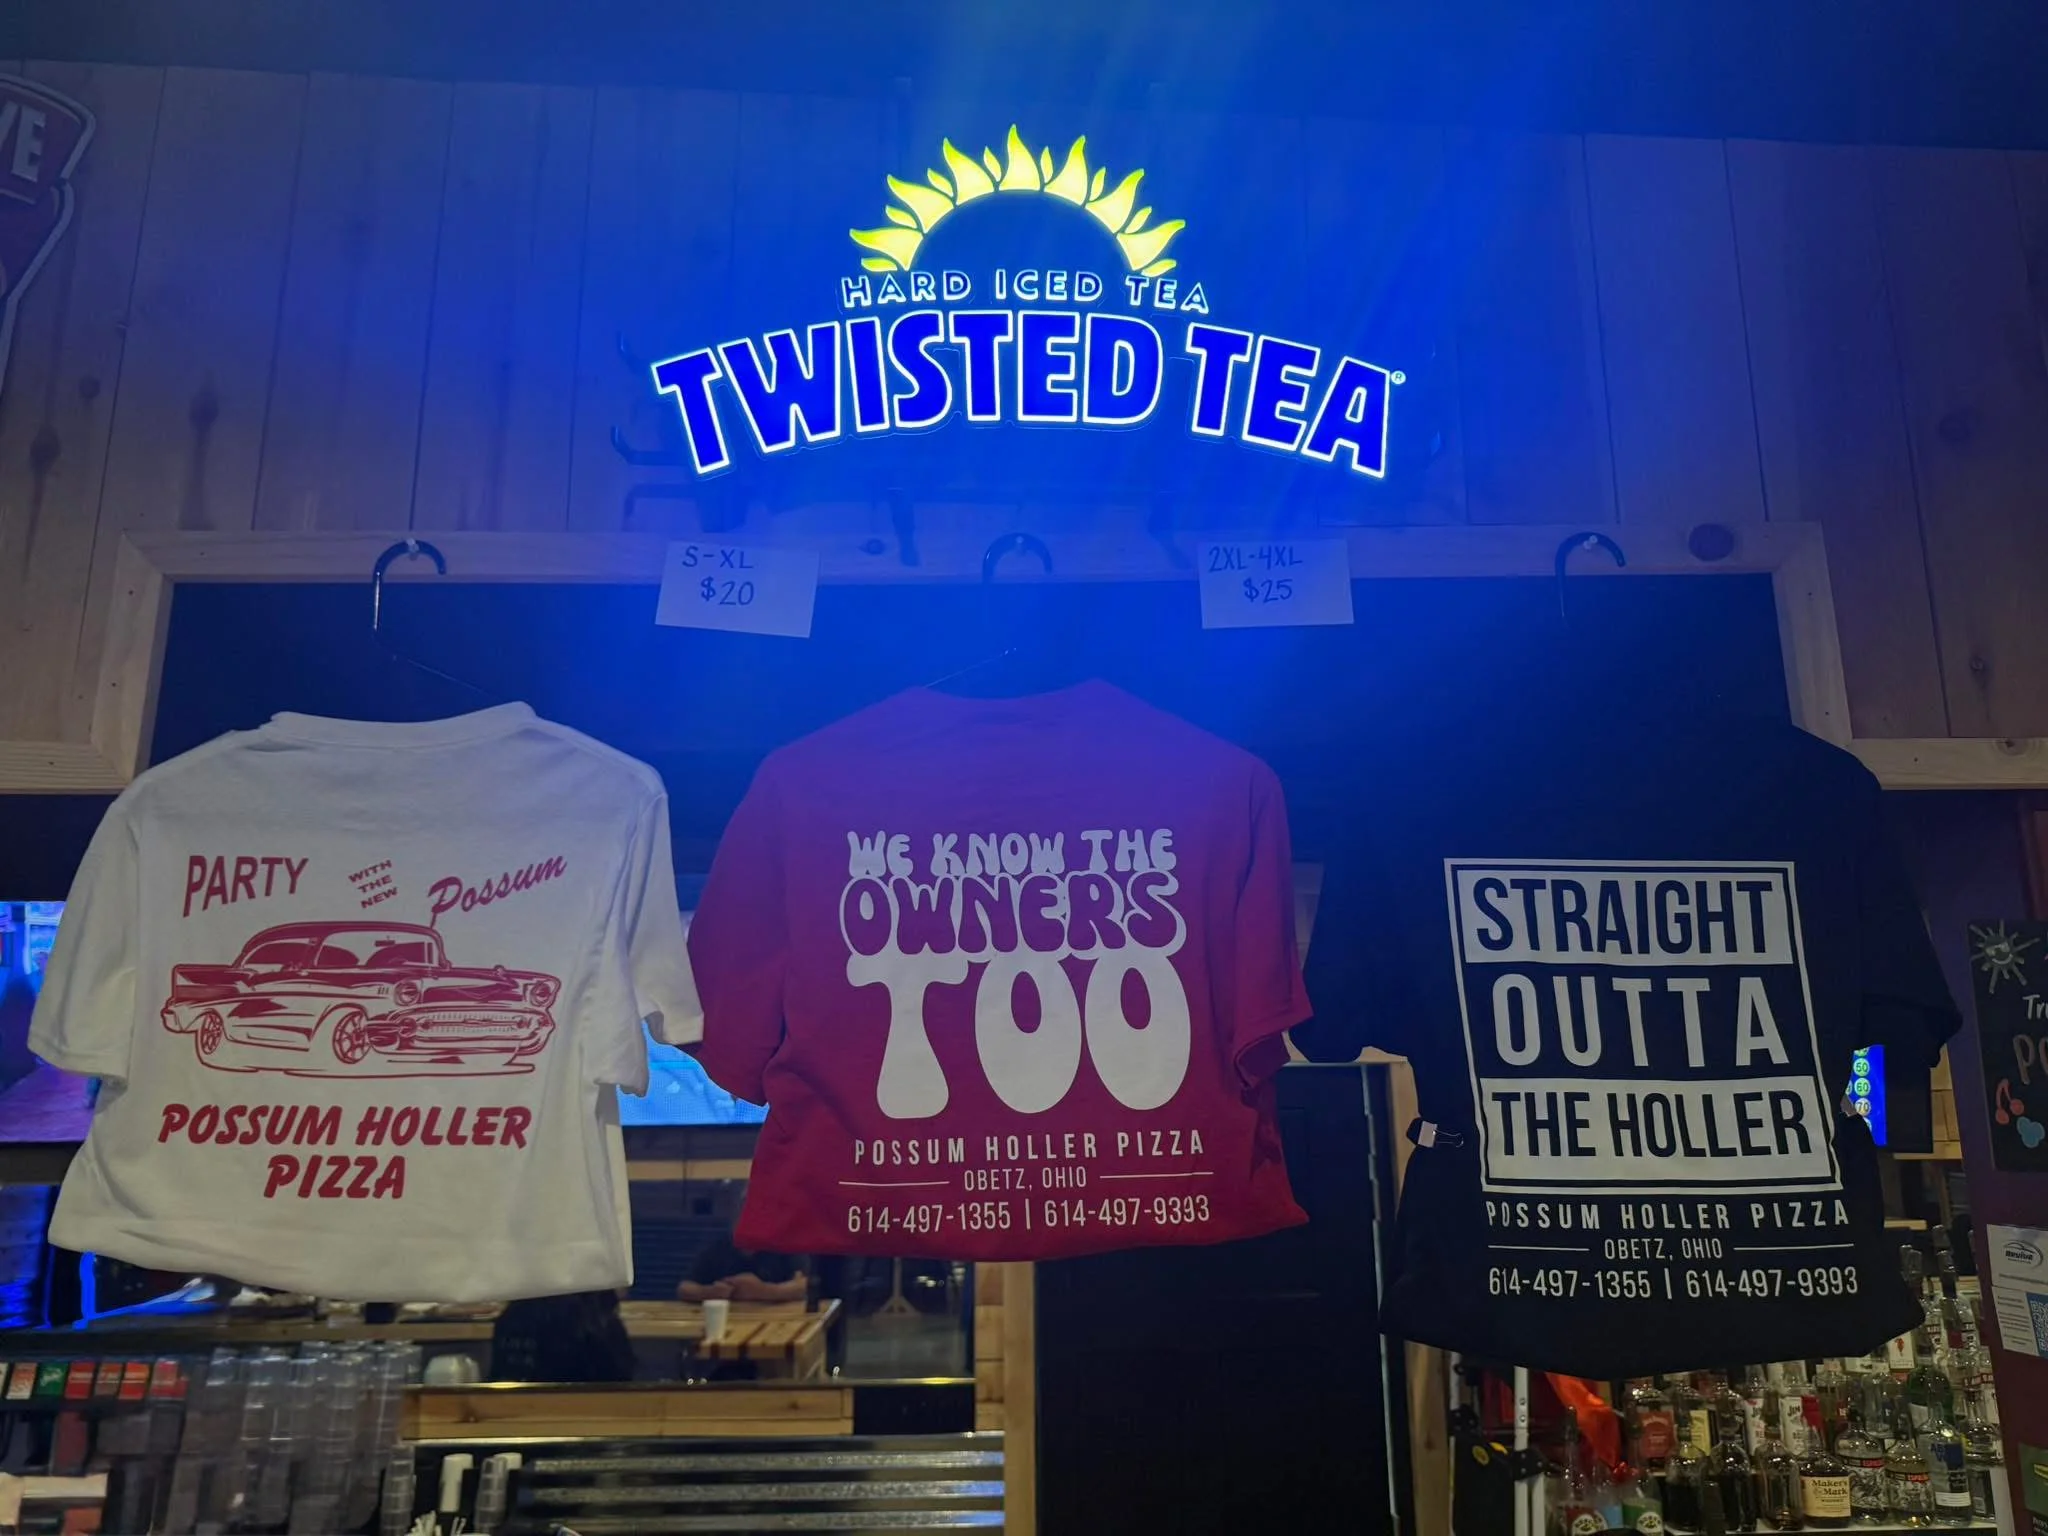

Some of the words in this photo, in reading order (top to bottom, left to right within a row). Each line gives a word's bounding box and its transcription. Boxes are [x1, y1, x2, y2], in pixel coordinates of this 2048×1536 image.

[841, 270, 971, 308] HARD
[995, 269, 1102, 302] ICED
[1125, 276, 1210, 313] TEA
[652, 310, 1165, 476] TWISTED
[682, 545, 754, 569] S-XL
[1209, 545, 1303, 573] 2XL-4XL
[701, 576, 755, 606] $20
[1243, 577, 1293, 603] $25
[348, 860, 392, 883] WITH
[847, 830, 913, 877] WE
[930, 832, 1065, 876] KNOW
[1081, 829, 1177, 872] THE
[183, 855, 309, 918] PARTY
[358, 875, 392, 893] THE
[361, 887, 398, 908] NEW
[427, 856, 568, 914] Possum
[840, 870, 1187, 962] OWNERS
[1473, 877, 1773, 955] STRAIGHT
[847, 952, 1191, 1119] TOO
[1492, 973, 1790, 1067] OUTTA
[1855, 1062, 1869, 1072] 50
[157, 1103, 343, 1145] POSSUM
[355, 1106, 532, 1149] HOLLER
[1491, 1092, 1597, 1157] THE
[1607, 1089, 1812, 1158] HOLLER
[855, 1138, 965, 1165] POSSUM
[986, 1132, 1097, 1161] HOLLER
[1118, 1129, 1204, 1157] PIZZA
[263, 1155, 406, 1199] PIZZA
[964, 1168, 1033, 1192] OBETZ,
[1042, 1166, 1088, 1189] OHIO
[848, 1202, 1011, 1233] 614-497-1355
[1044, 1195, 1210, 1227] 614-497-9393
[1485, 1201, 1600, 1229] POSSUM
[1621, 1203, 1730, 1229] HOLLER
[1752, 1200, 1849, 1228] PIZZA
[1604, 1239, 1673, 1260] OBETZ,
[1681, 1238, 1723, 1259] OHIO
[1489, 1268, 1651, 1298] 614-497-1355
[1685, 1266, 1858, 1297] 614-497-9393
